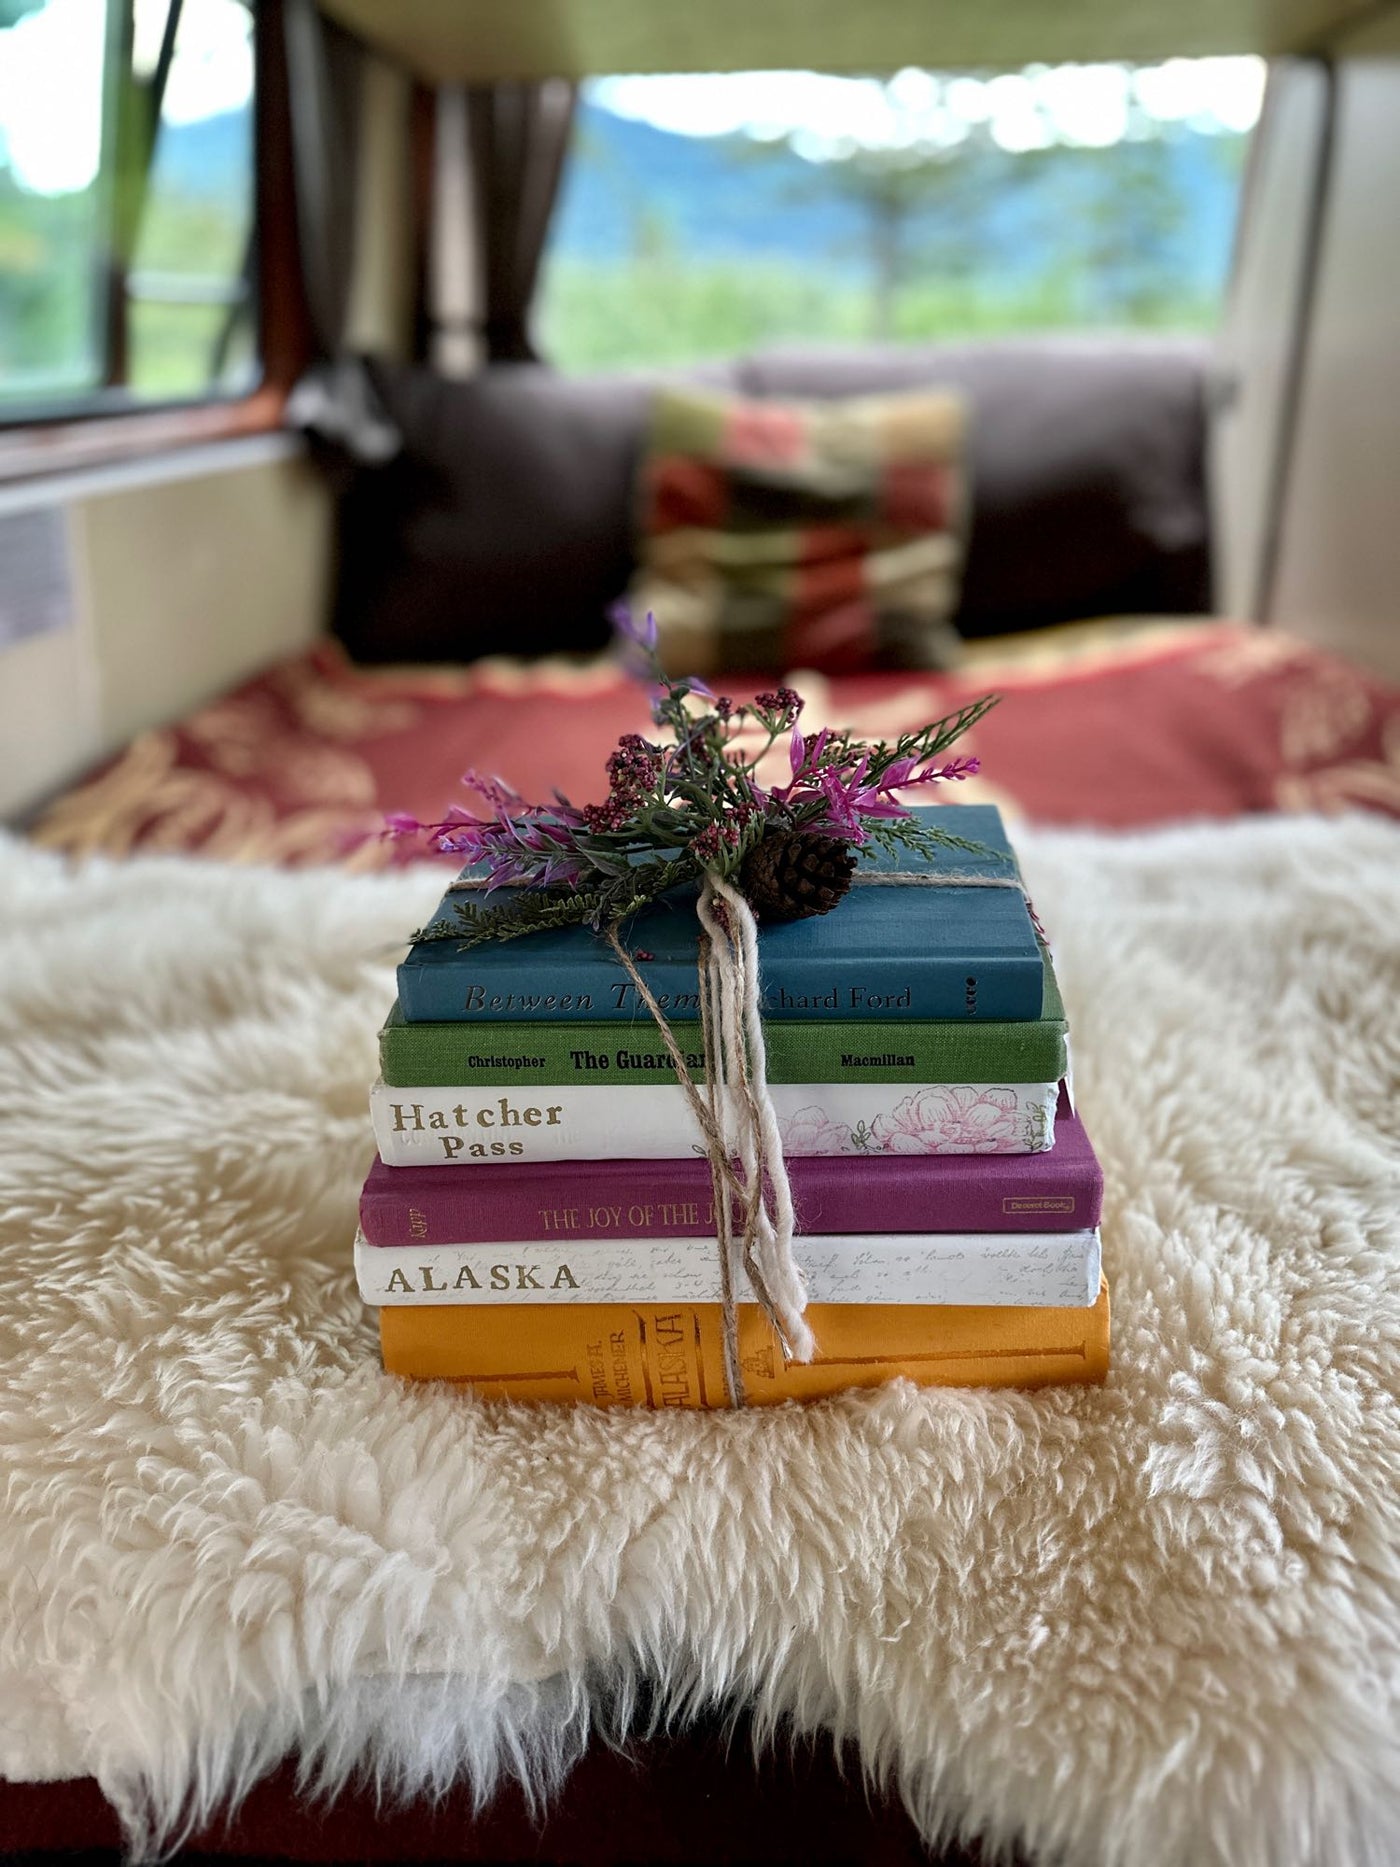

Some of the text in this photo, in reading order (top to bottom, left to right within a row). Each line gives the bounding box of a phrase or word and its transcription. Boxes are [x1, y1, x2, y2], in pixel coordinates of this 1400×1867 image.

[464, 985, 596, 1012] Between
[766, 986, 911, 1010] chard Ford
[468, 1055, 546, 1069] Christopher
[570, 1051, 706, 1070] The Guarda
[841, 1054, 915, 1066] Macmillan
[390, 1098, 563, 1132] Hatcher
[438, 1136, 525, 1159] Pass
[538, 1209, 581, 1231] THE
[586, 1207, 622, 1229] JOY
[628, 1205, 654, 1227] OF
[658, 1203, 698, 1226] THE
[384, 1264, 581, 1293] ALASKA
[654, 1313, 692, 1408] ALASKA
